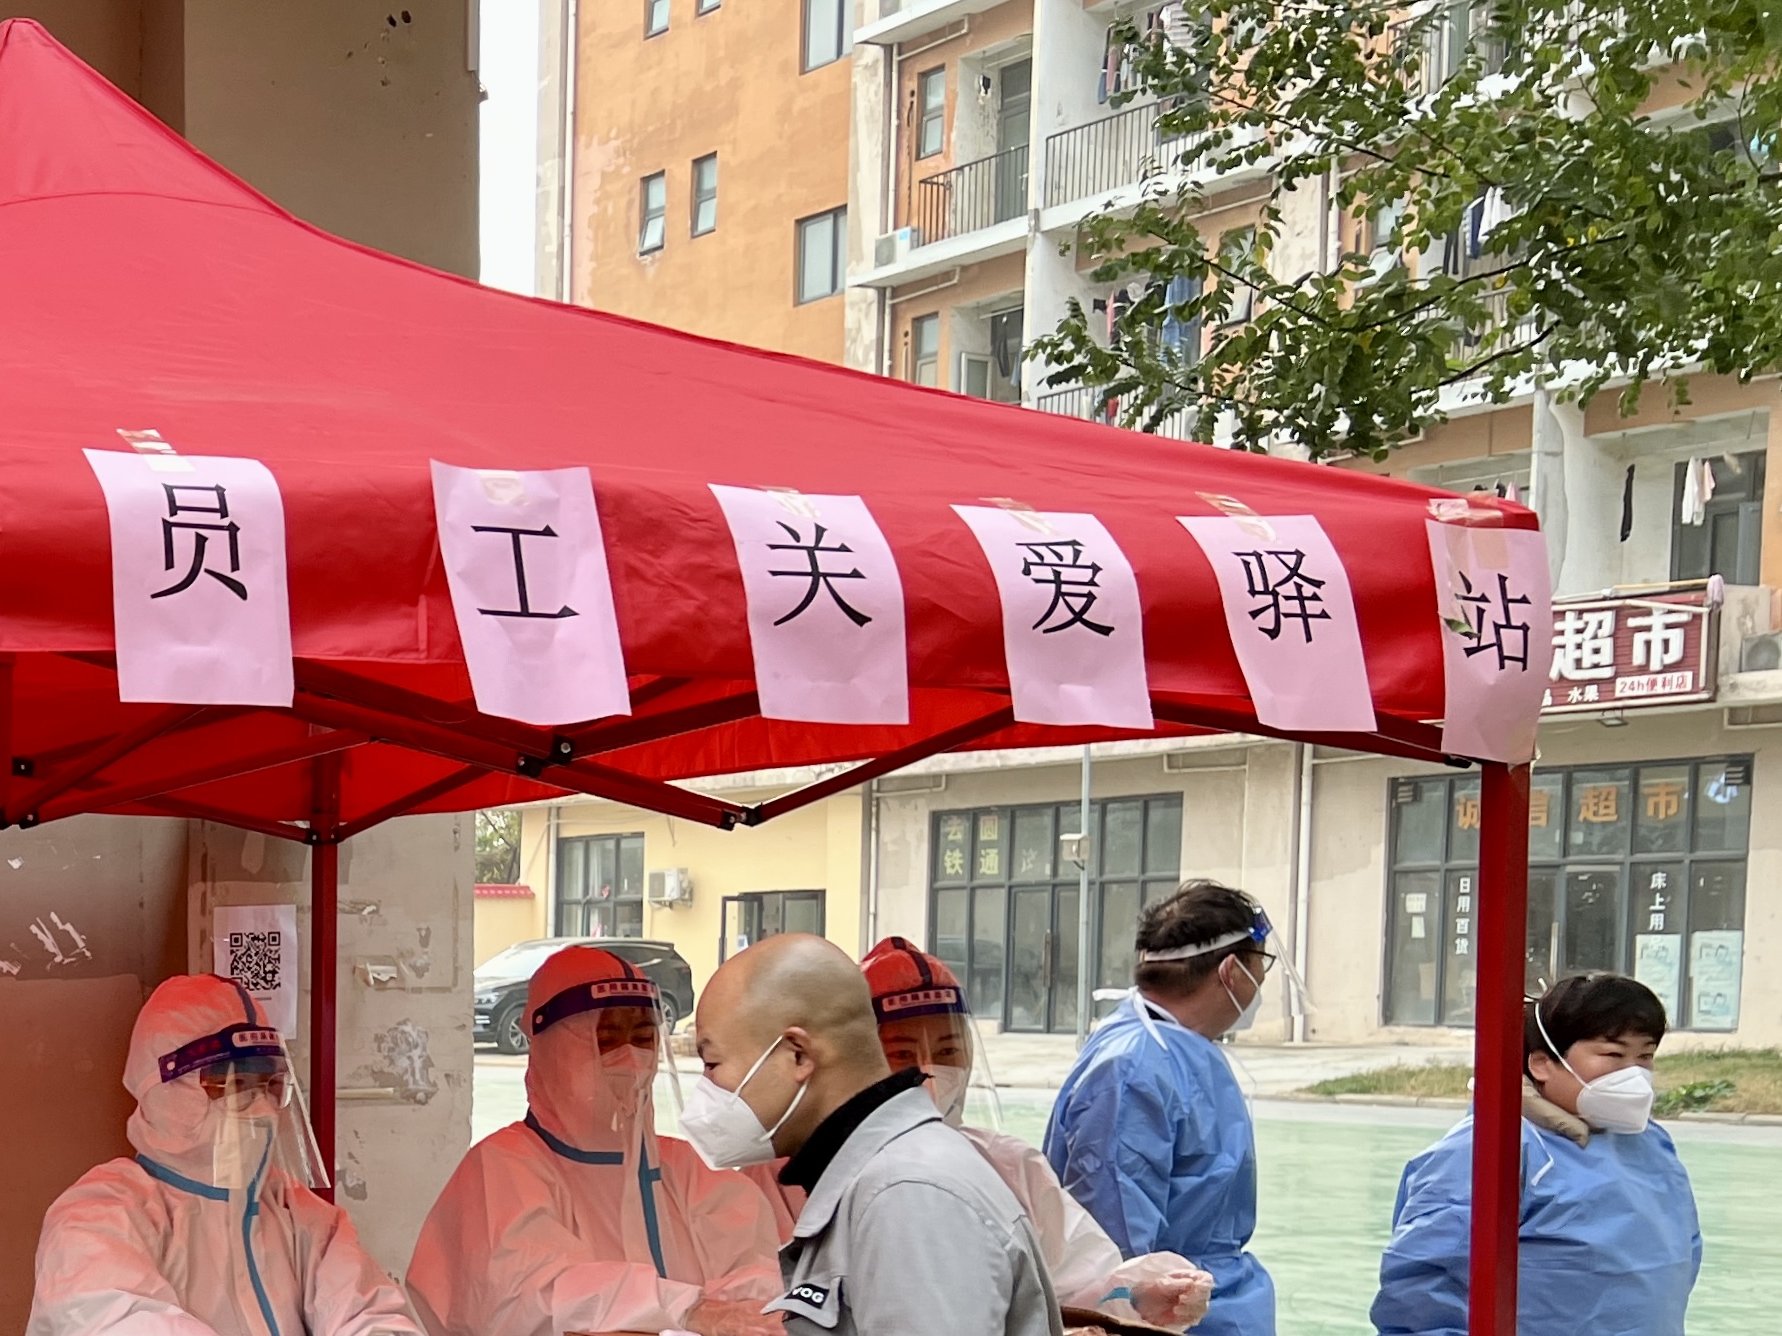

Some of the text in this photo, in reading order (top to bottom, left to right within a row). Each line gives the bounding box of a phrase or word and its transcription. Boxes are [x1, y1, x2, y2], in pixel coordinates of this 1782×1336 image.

[1549, 607, 1694, 682] 超市
[1566, 684, 1600, 704] 水果
[1619, 672, 1689, 693] 24h便利店
[1454, 876, 1472, 956] 日用百货
